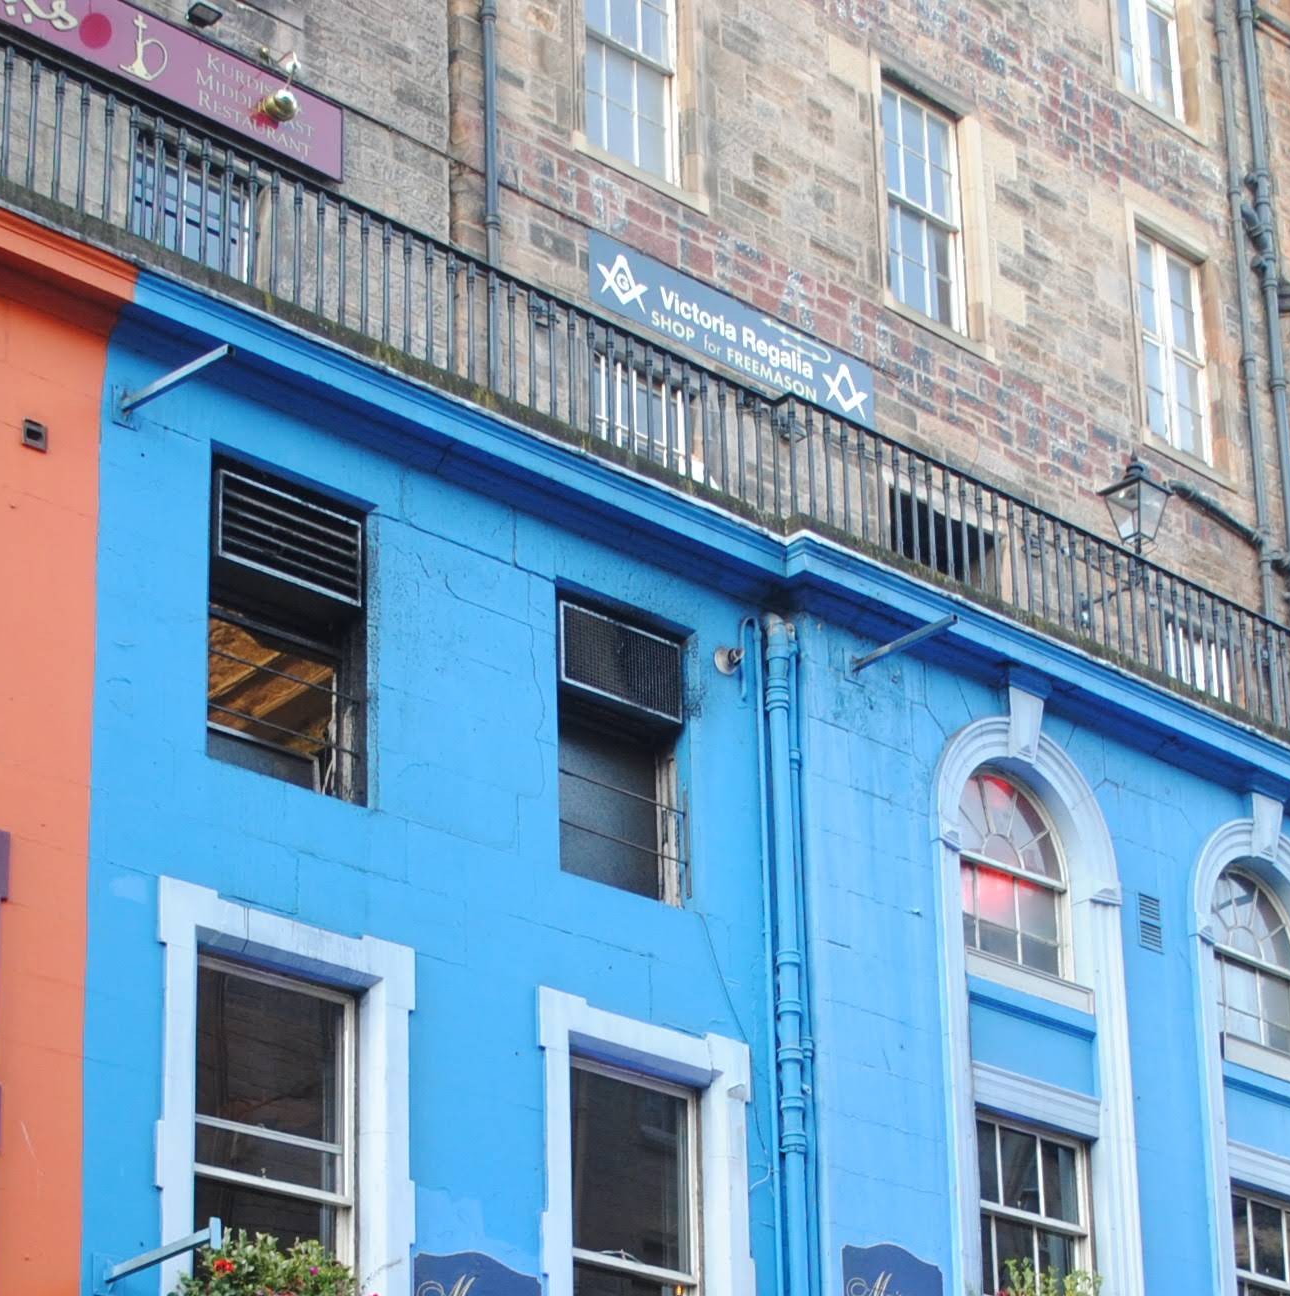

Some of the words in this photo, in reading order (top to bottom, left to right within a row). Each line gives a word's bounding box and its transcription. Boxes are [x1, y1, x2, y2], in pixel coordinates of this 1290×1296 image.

[207, 53, 273, 97] KURDIS
[198, 90, 311, 158] RESTAURANT
[651, 311, 696, 342] SHOP
[703, 334, 721, 356] for
[726, 348, 819, 403] FREEMASON
[659, 285, 737, 342] Victoria
[742, 326, 815, 381] Regalia
